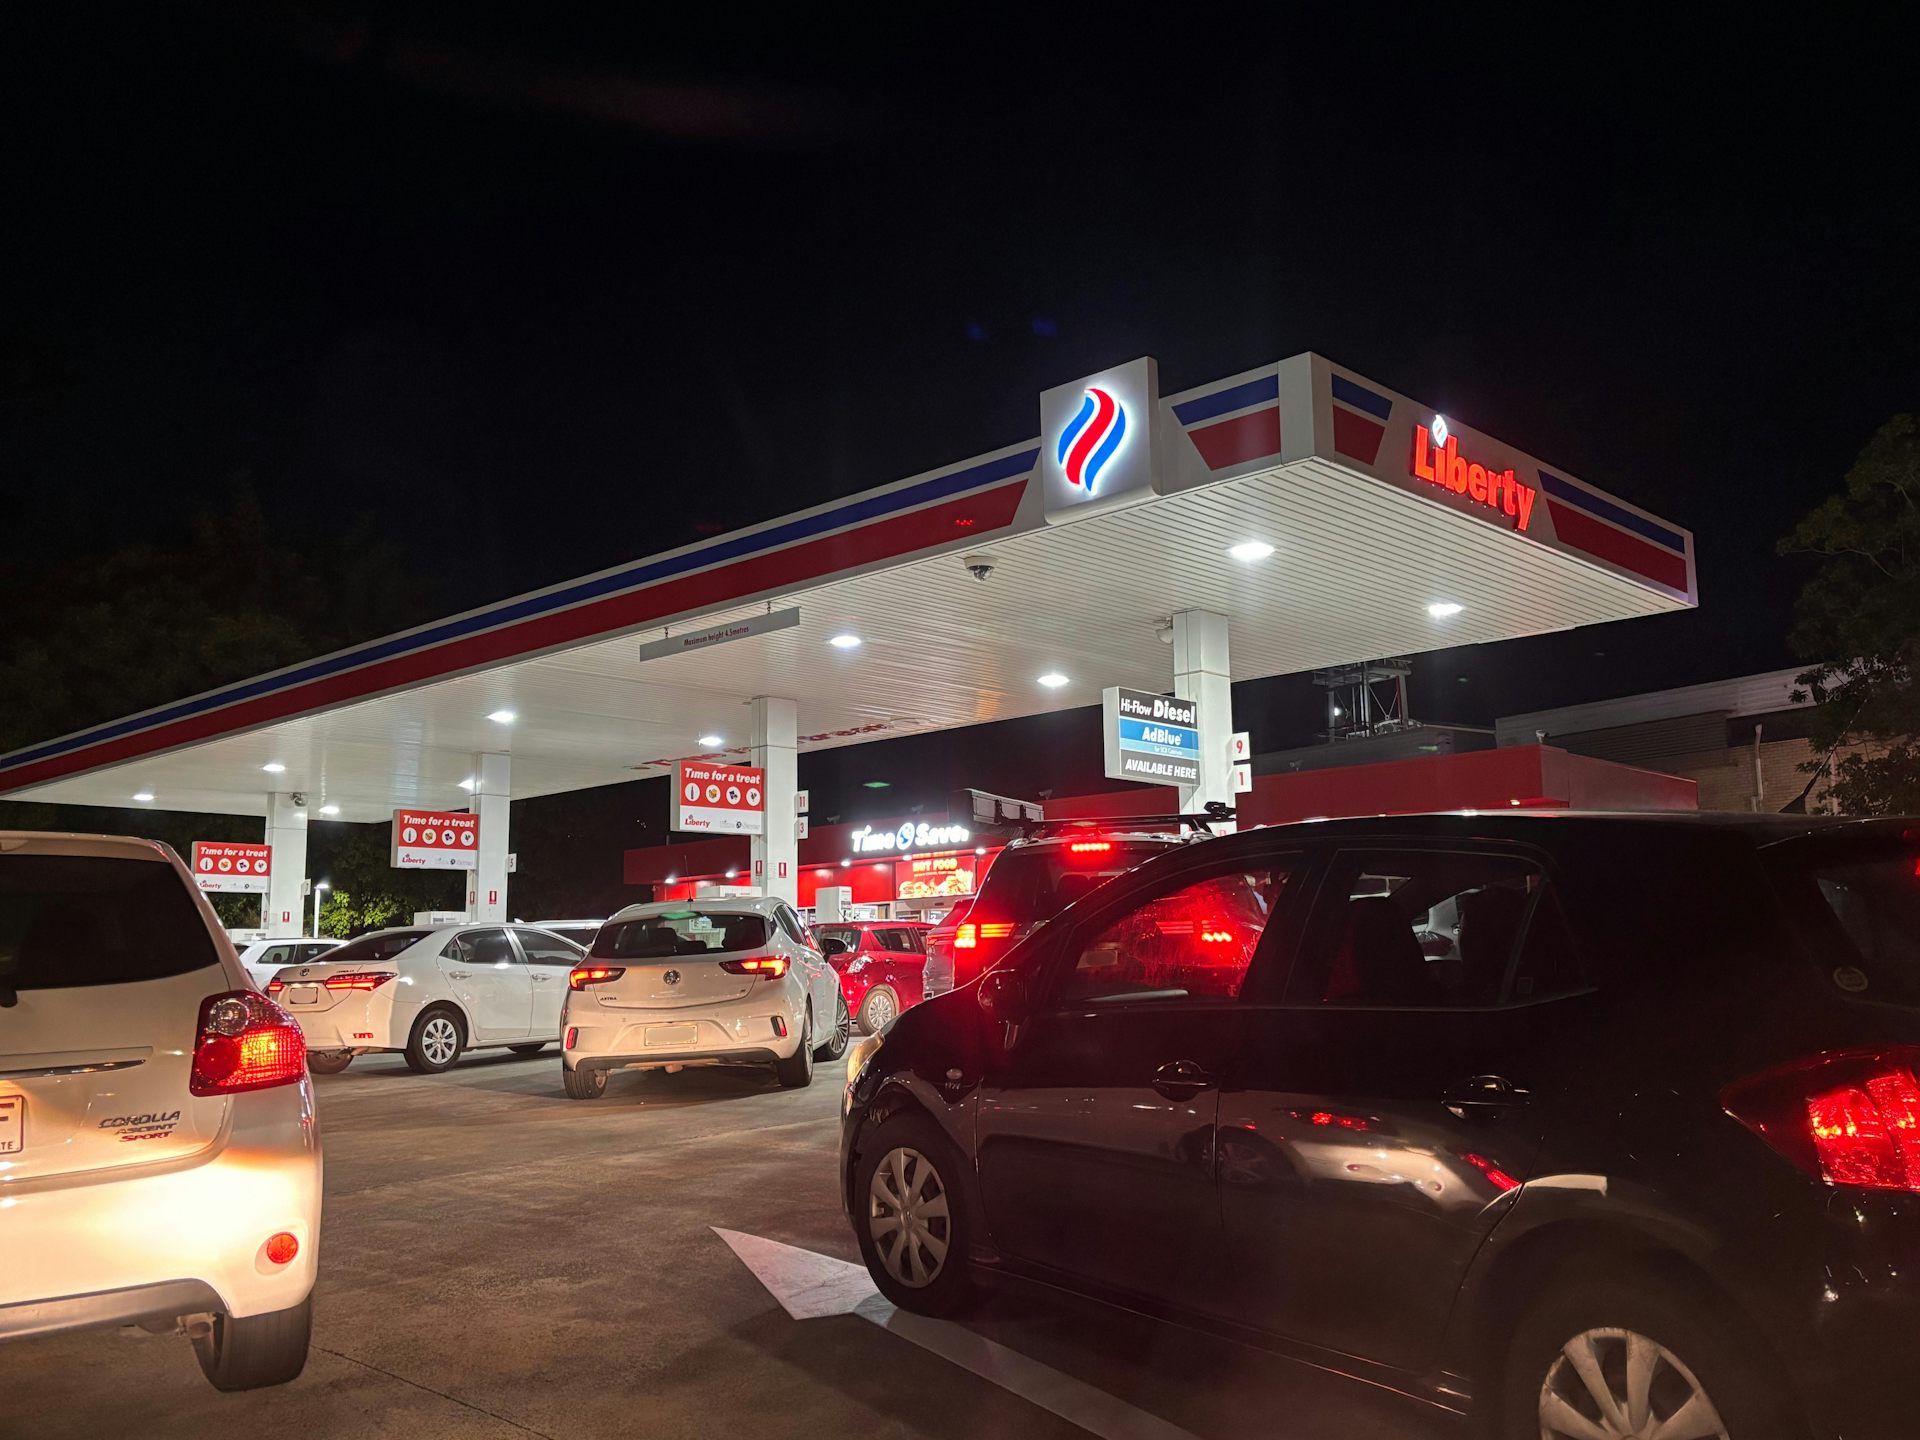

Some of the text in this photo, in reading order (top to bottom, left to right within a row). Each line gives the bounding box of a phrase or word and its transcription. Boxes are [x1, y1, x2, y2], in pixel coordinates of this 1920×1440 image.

[1415, 424, 1536, 531] Liberty
[684, 636, 707, 646] Maximum
[708, 631, 724, 641] height
[1120, 698, 1196, 724] Hi-Flow Diesel
[1141, 727, 1182, 746] AdBlue
[1236, 740, 1243, 753] 9
[1125, 758, 1197, 779] AVAILABLE HERE
[684, 767, 710, 780] Time
[711, 770, 727, 781] for
[736, 773, 760, 784] treat
[1239, 772, 1244, 786] 1
[799, 796, 806, 807] 11
[403, 815, 426, 826] Time
[428, 816, 443, 826] for
[451, 818, 475, 828] treat
[685, 817, 711, 828] Liberty
[799, 822, 805, 833] 3
[852, 825, 895, 852] Time
[200, 847, 222, 856] Time
[224, 848, 238, 857] for
[246, 849, 268, 858] treat
[402, 857, 426, 865] Liberty
[933, 858, 958, 871] FOOD
[98, 1110, 181, 1128] COROLLA
[115, 1123, 177, 1135] ASCENT
[120, 1131, 173, 1142] SPORT
[0, 1141, 14, 1151] TE
